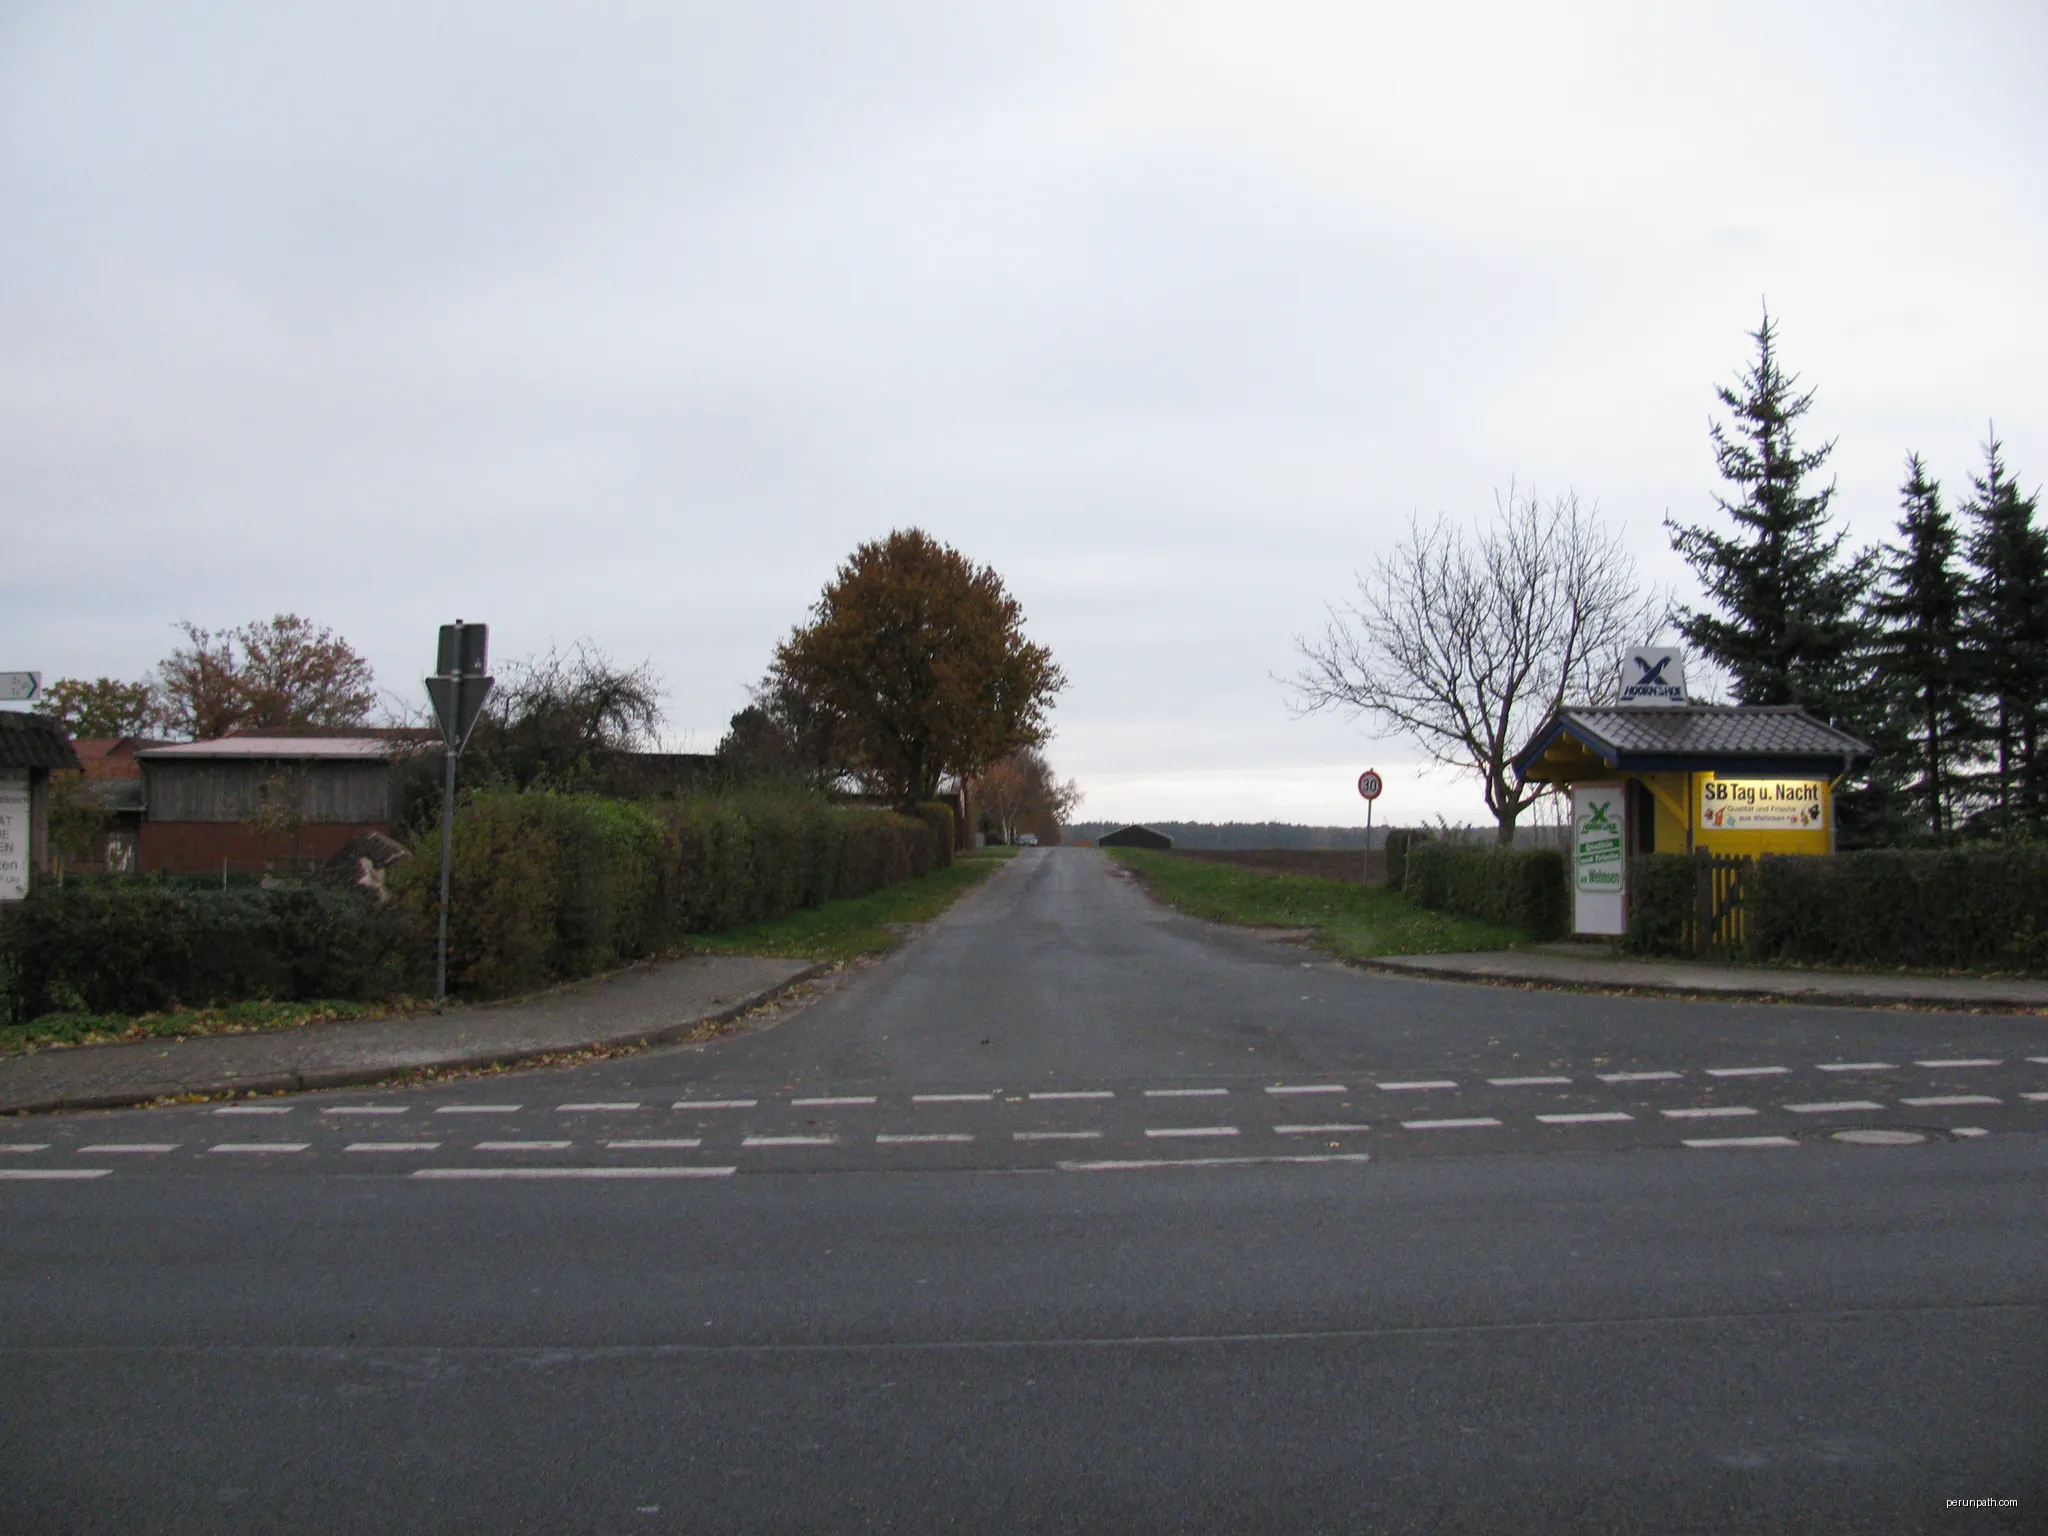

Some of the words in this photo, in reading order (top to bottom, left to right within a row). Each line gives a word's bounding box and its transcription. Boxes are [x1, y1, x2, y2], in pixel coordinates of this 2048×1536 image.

[1362, 779, 1377, 792] 30
[1705, 782, 1728, 800] SB
[1730, 783, 1755, 804] Tag
[1759, 786, 1772, 800] u.
[1775, 783, 1818, 800] Nacht
